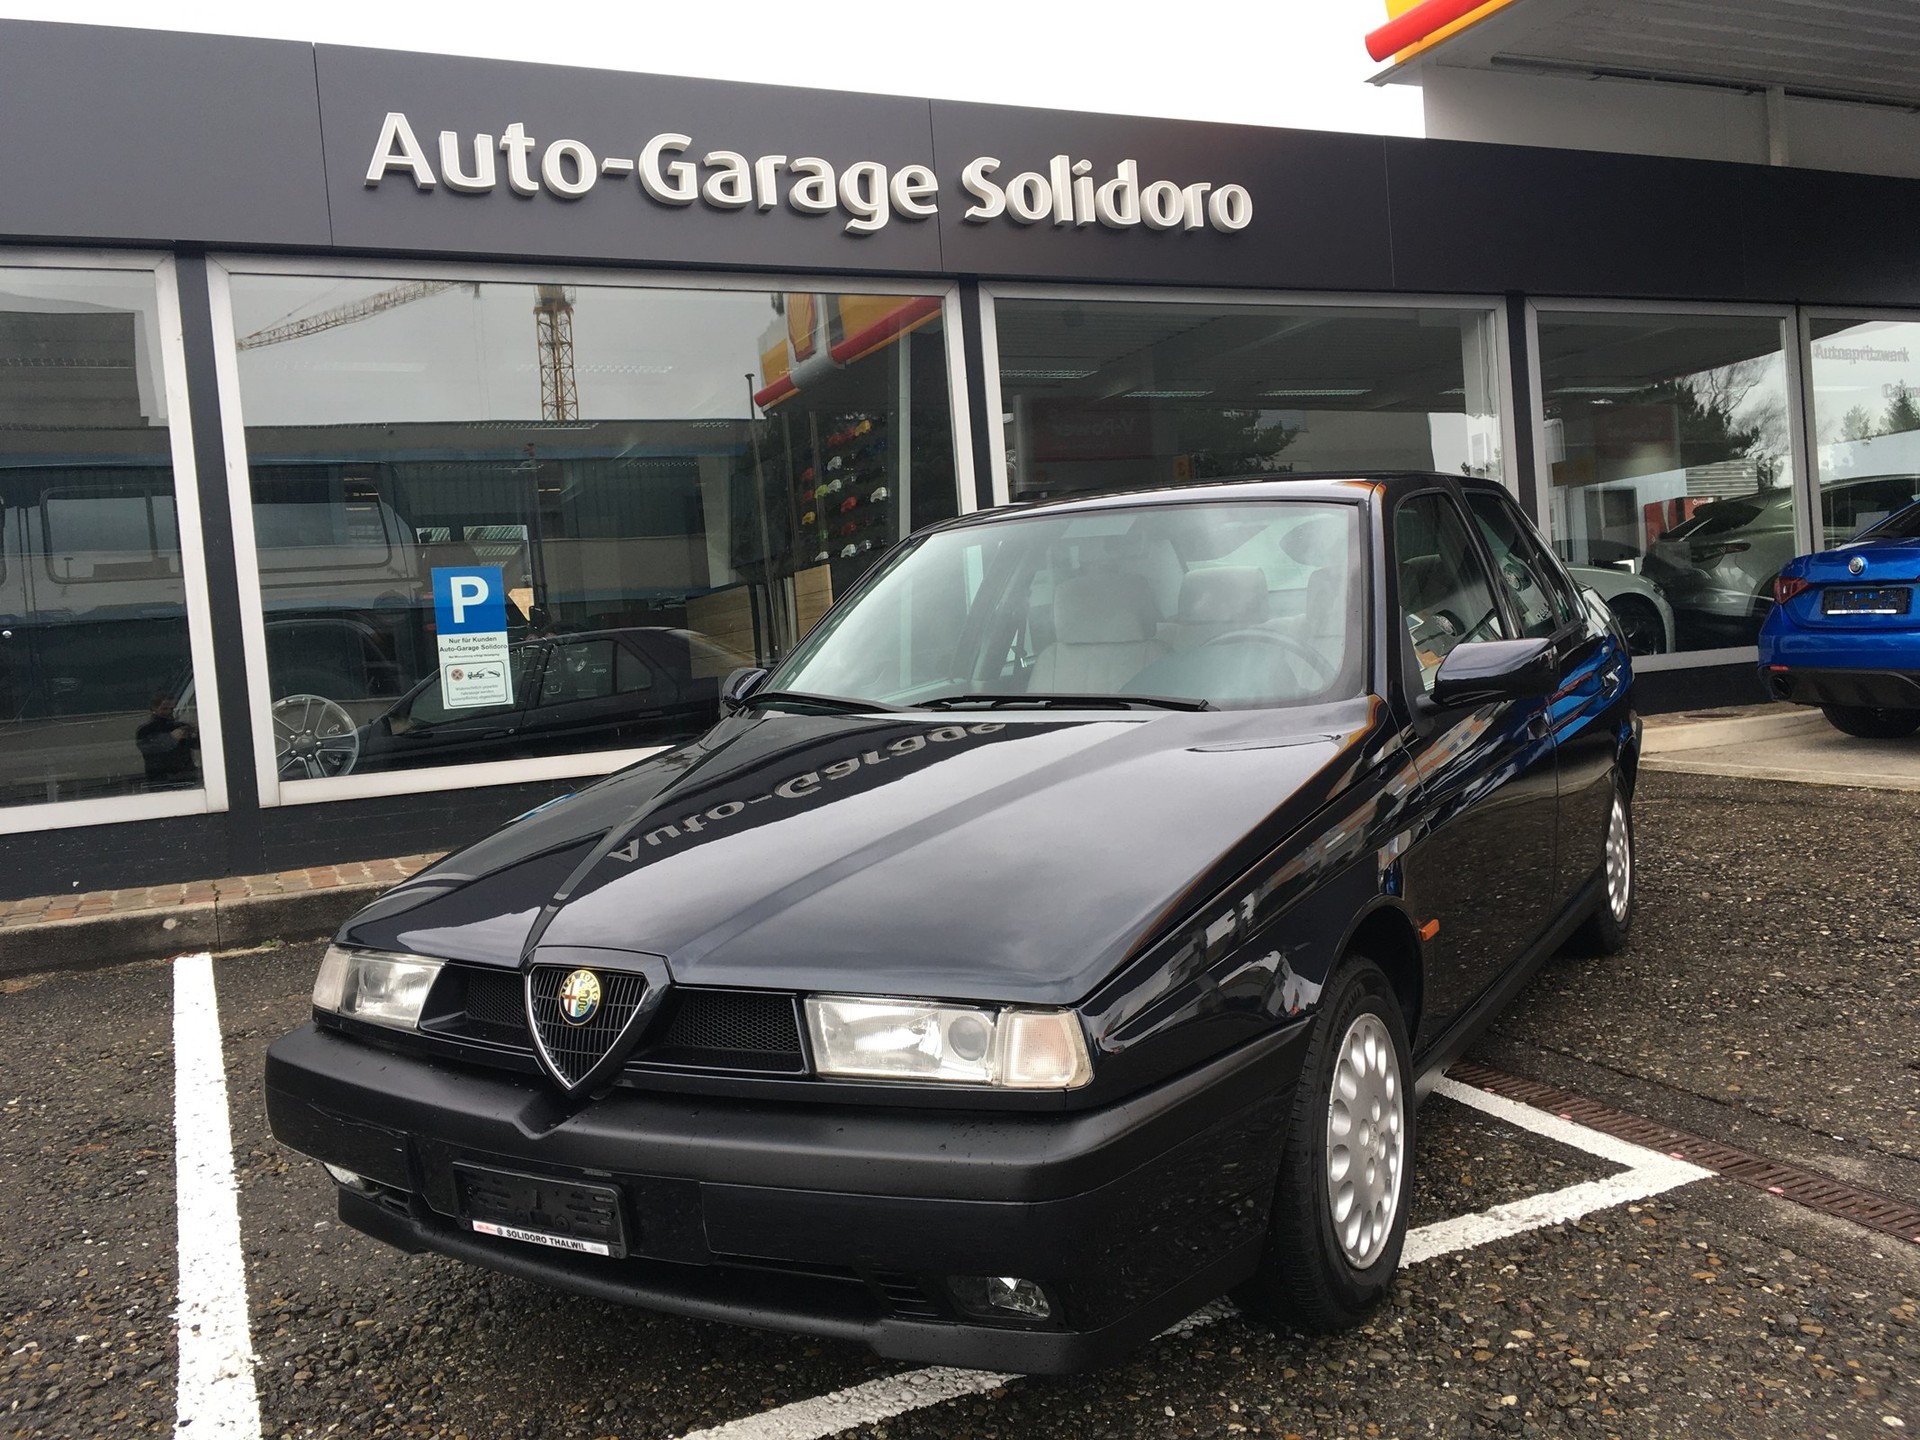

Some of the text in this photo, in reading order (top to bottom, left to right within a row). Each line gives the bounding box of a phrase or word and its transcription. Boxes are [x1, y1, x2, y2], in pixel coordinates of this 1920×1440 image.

[364, 111, 1253, 235] Auto-Garage Solidoro
[450, 576, 489, 624] P
[506, 1229, 547, 1244] SOLIDORO
[549, 1237, 587, 1251] THALWIL
